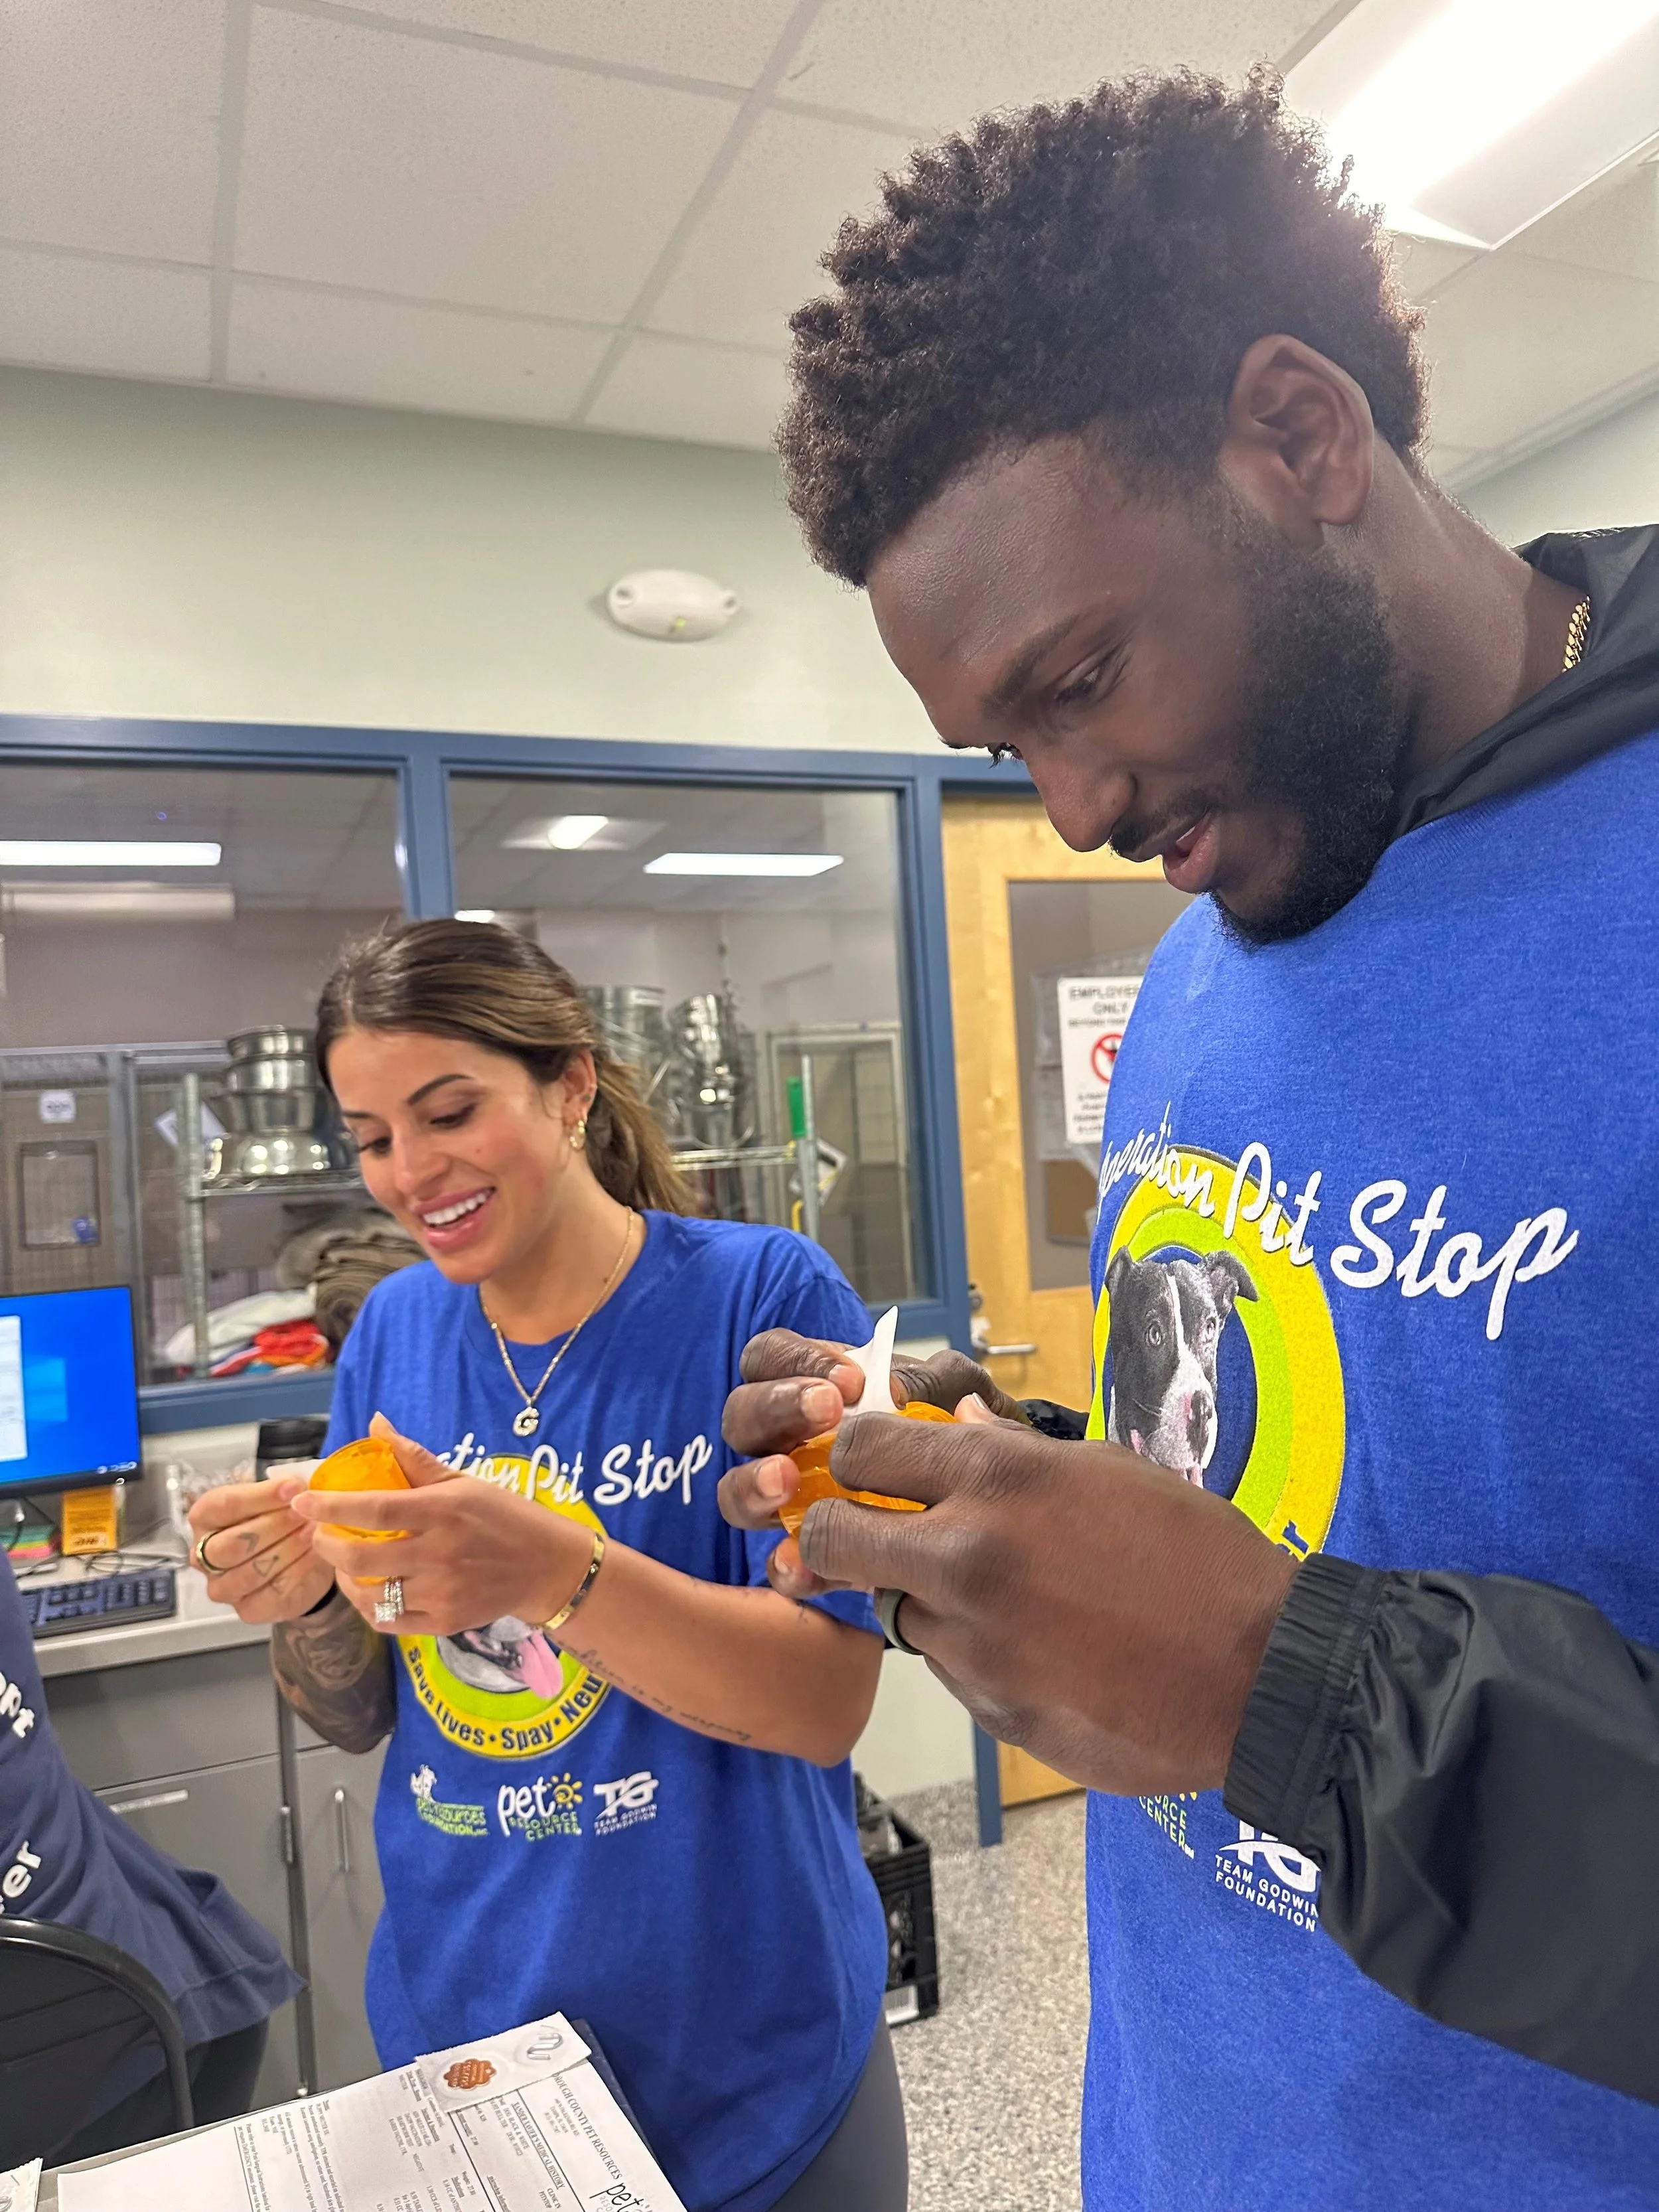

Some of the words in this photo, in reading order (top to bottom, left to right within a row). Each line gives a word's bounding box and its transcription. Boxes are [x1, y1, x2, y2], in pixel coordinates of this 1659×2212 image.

[1092, 1001, 1128, 1015] ONLY
[1097, 1100, 1215, 1225] peration
[1224, 1142, 1322, 1266] Pit
[1330, 1179, 1580, 1341] Stop
[436, 1432, 522, 1495] tion
[526, 1444, 584, 1504] Pit
[593, 1434, 713, 1506] Stop
[0, 1672, 35, 1739] pt
[409, 1646, 435, 1705] Save
[436, 1700, 486, 1746] Lives
[501, 1720, 553, 1751] Spay
[560, 1673, 603, 1724] Neu
[498, 1776, 556, 1838] pet
[508, 1811, 577, 1830] RESOURCE
[525, 1822, 579, 1842] CENTER
[1139, 1796, 1185, 1850] CENTER
[0, 1840, 41, 1915] er
[1215, 1854, 1254, 1884] TEAM
[1258, 1878, 1319, 1919] GODWIN
[1215, 1870, 1315, 1933] FOUNDATION
[535, 2142, 552, 2166] MEDICAL
[547, 2165, 565, 2189] HISTORY
[567, 2097, 589, 2126] COUNTY
[583, 2124, 597, 2140] PET
[591, 2137, 622, 2180] RESOURCES
[539, 2191, 552, 2209] PITSTOP
[547, 2187, 559, 2203] CLINIC
